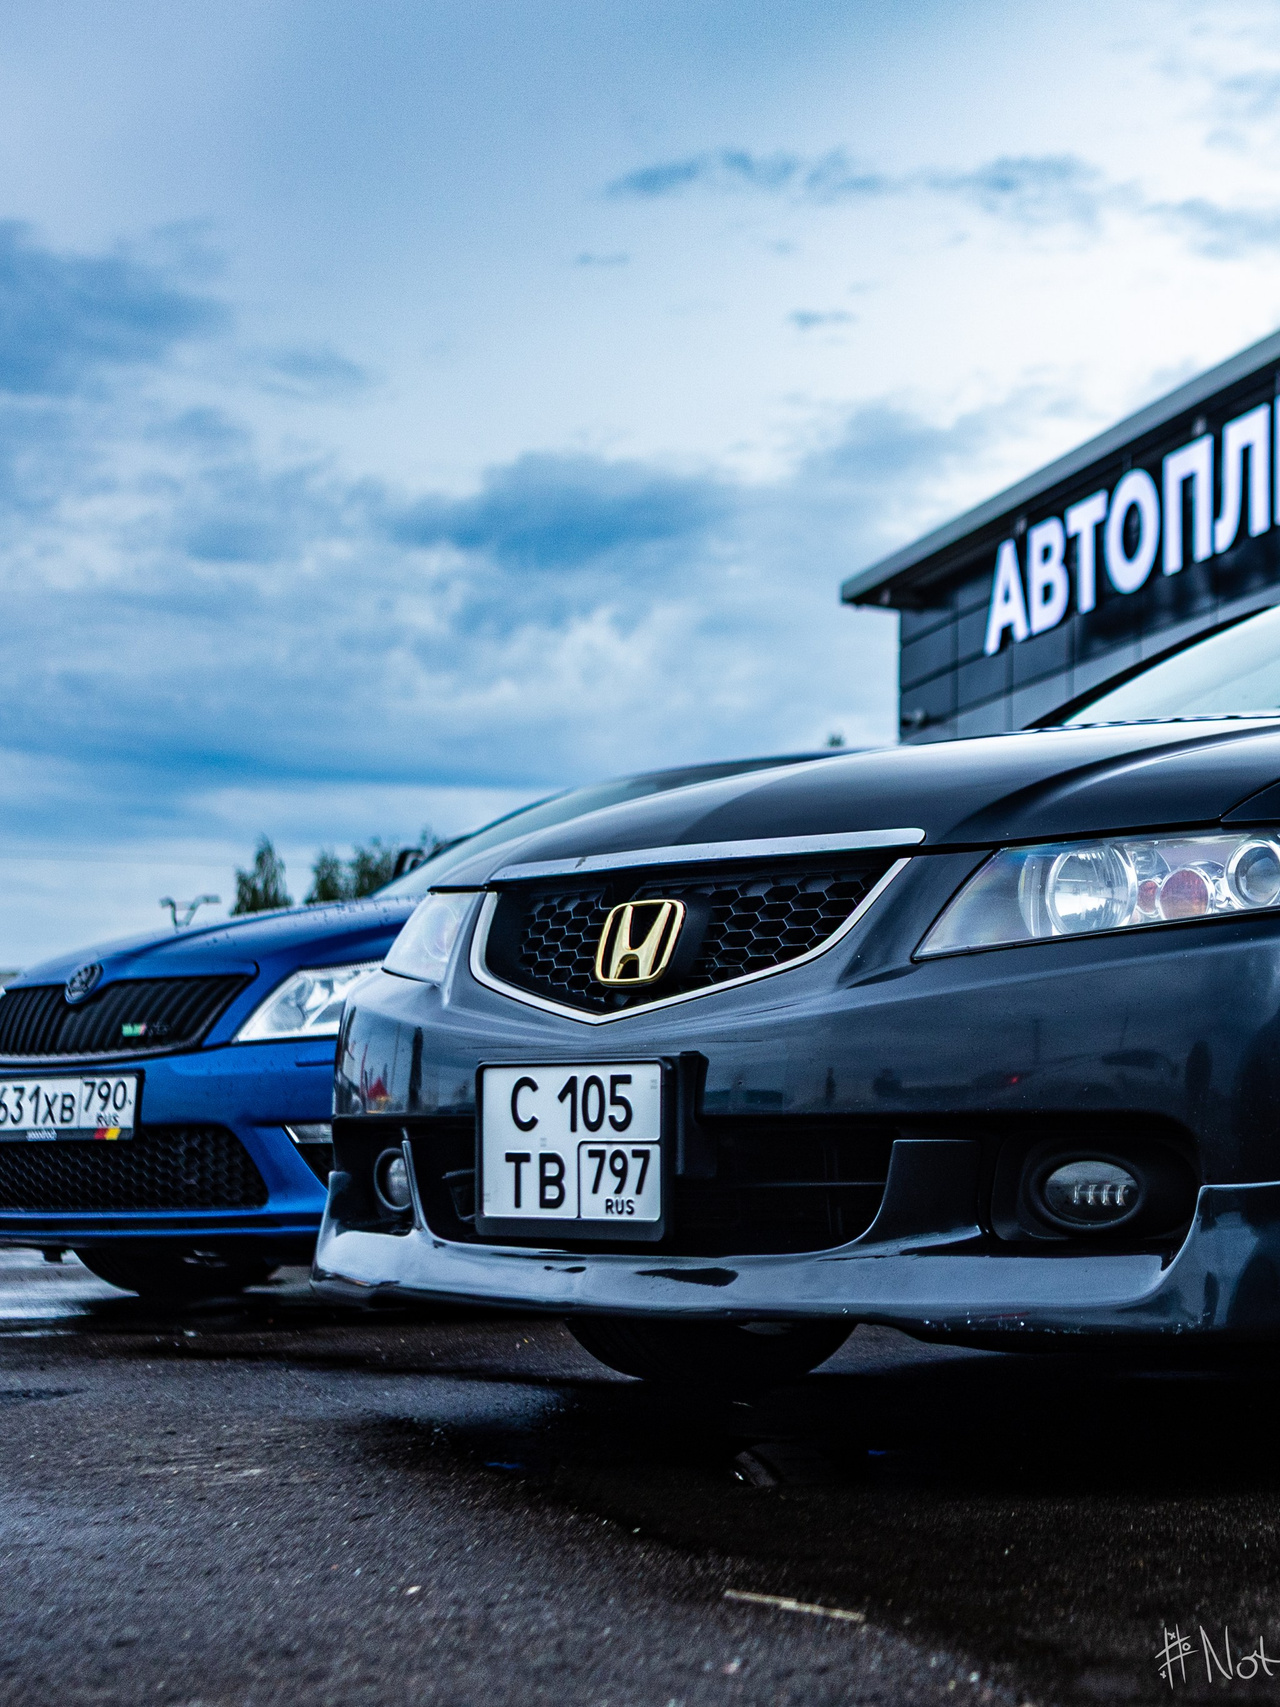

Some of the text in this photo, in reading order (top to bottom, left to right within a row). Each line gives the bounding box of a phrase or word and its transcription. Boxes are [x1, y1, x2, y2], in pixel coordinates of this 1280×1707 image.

[83, 1080, 127, 1112] 790
[511, 1074, 633, 1133] С 105
[96, 1112, 120, 1127] RUS
[505, 1149, 650, 1209] ТВ 797
[605, 1199, 635, 1216] RUS
